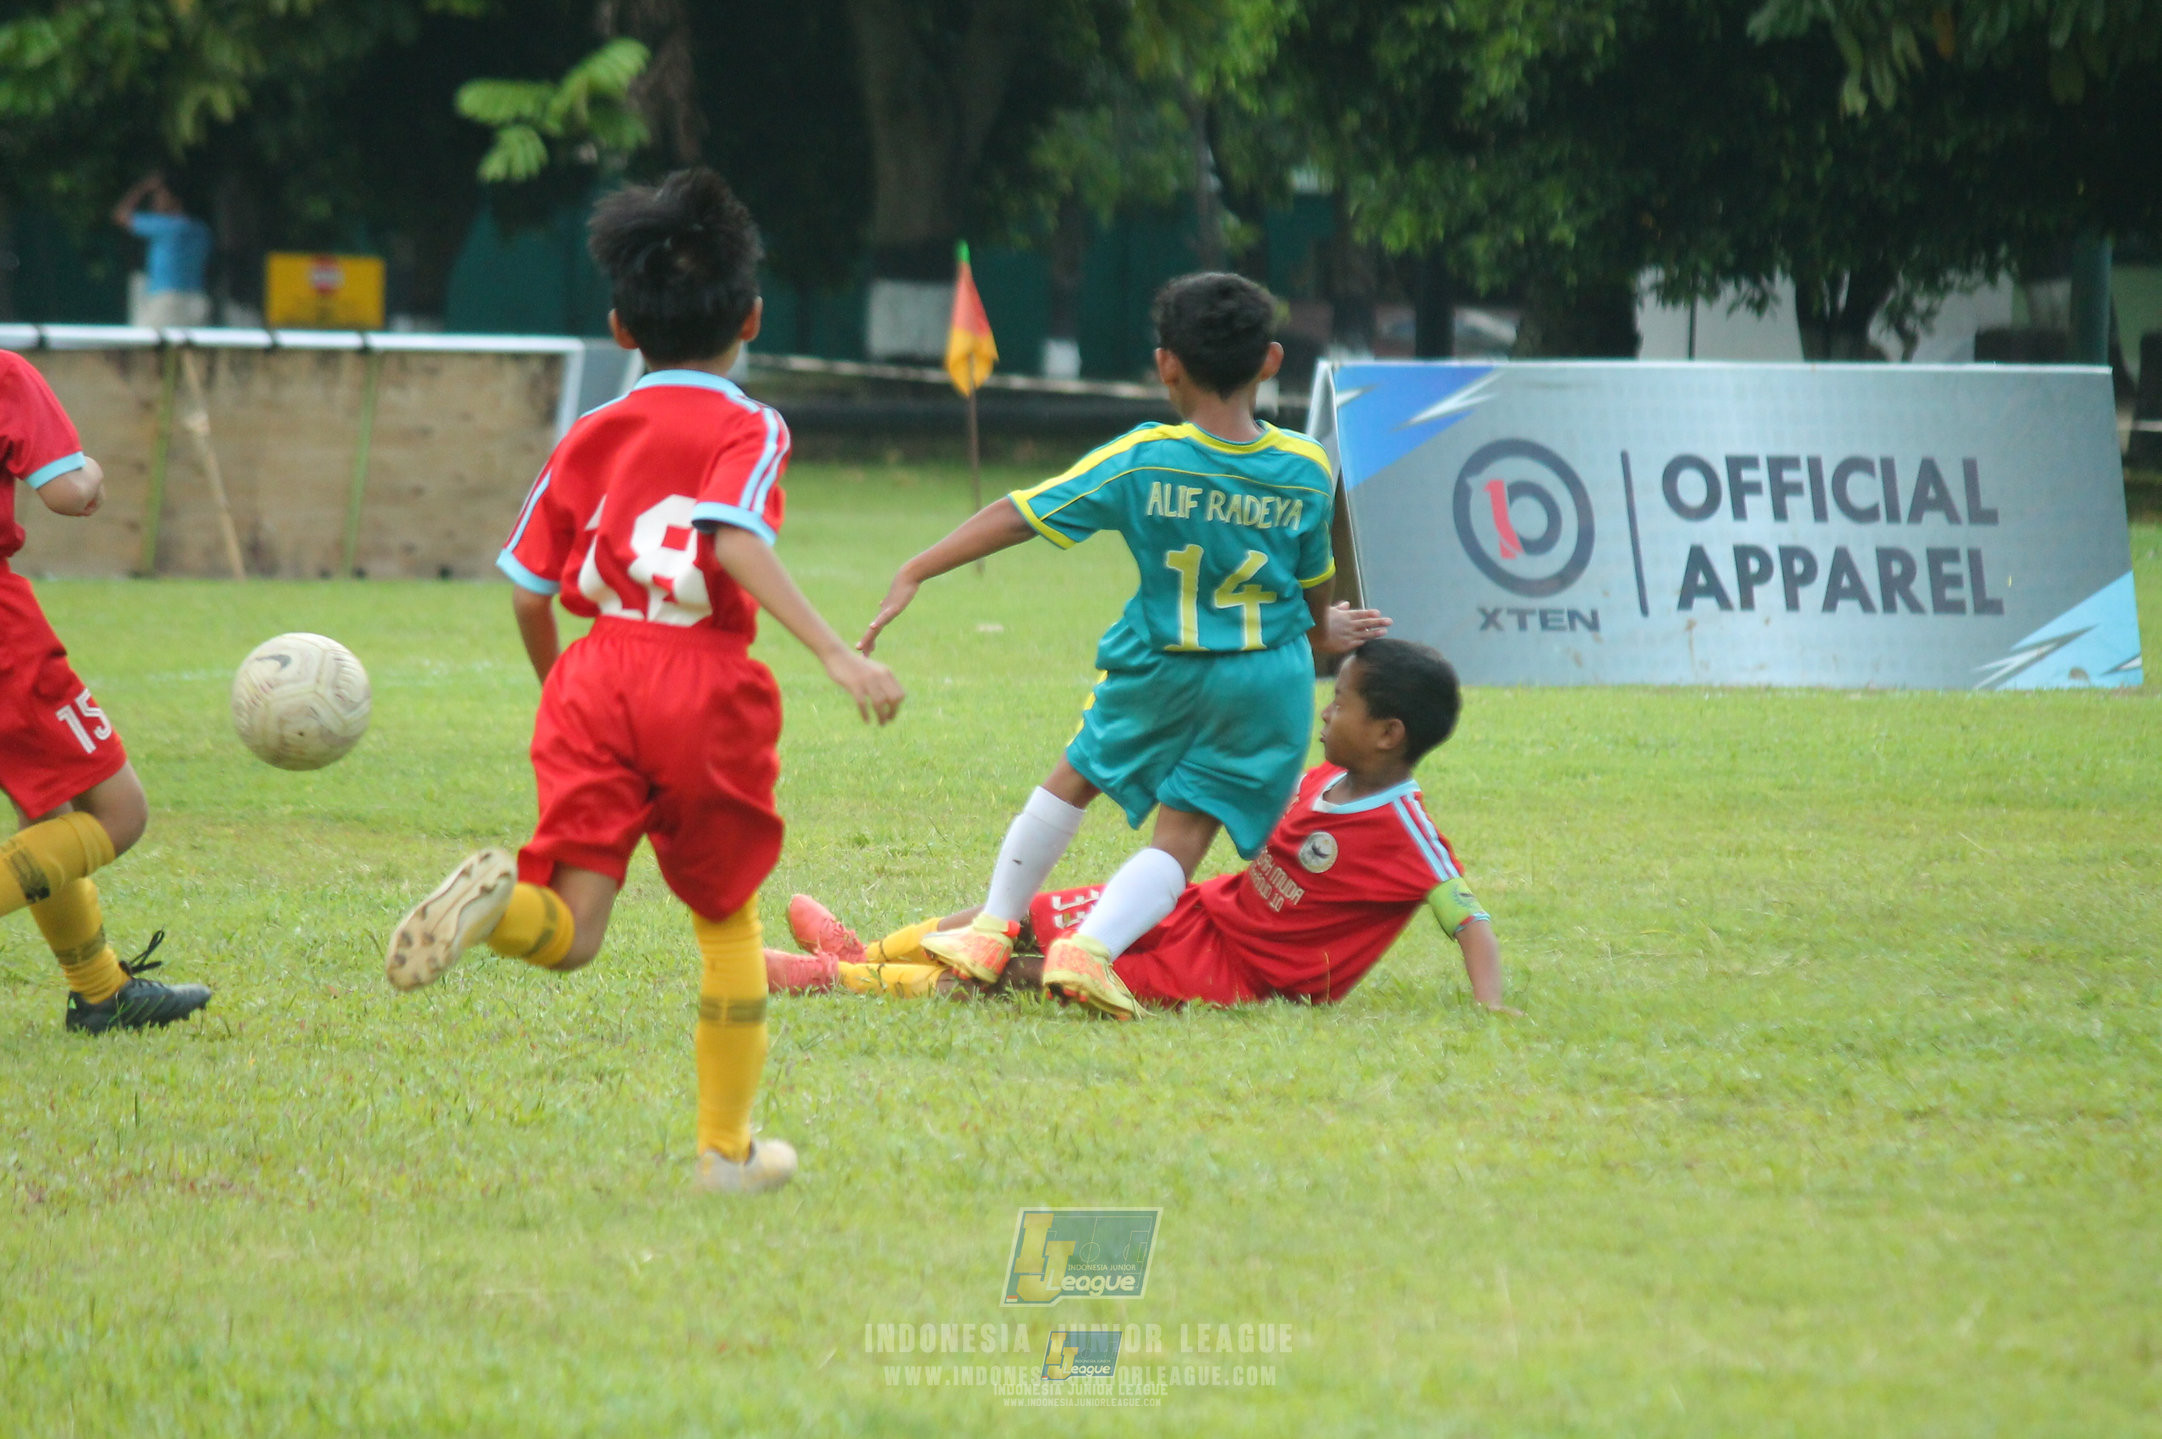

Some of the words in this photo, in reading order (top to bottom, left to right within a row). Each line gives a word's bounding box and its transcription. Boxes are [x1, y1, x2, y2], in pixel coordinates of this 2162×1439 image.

[1147, 481, 1203, 519] ALIF
[1208, 490, 1304, 530] RADEYA
[1662, 453, 1999, 526] OFFICIAL
[1164, 544, 1277, 651] 14
[1677, 544, 2004, 616] APPAREL
[1478, 607, 1600, 632] XTEN
[55, 688, 112, 754] 15
